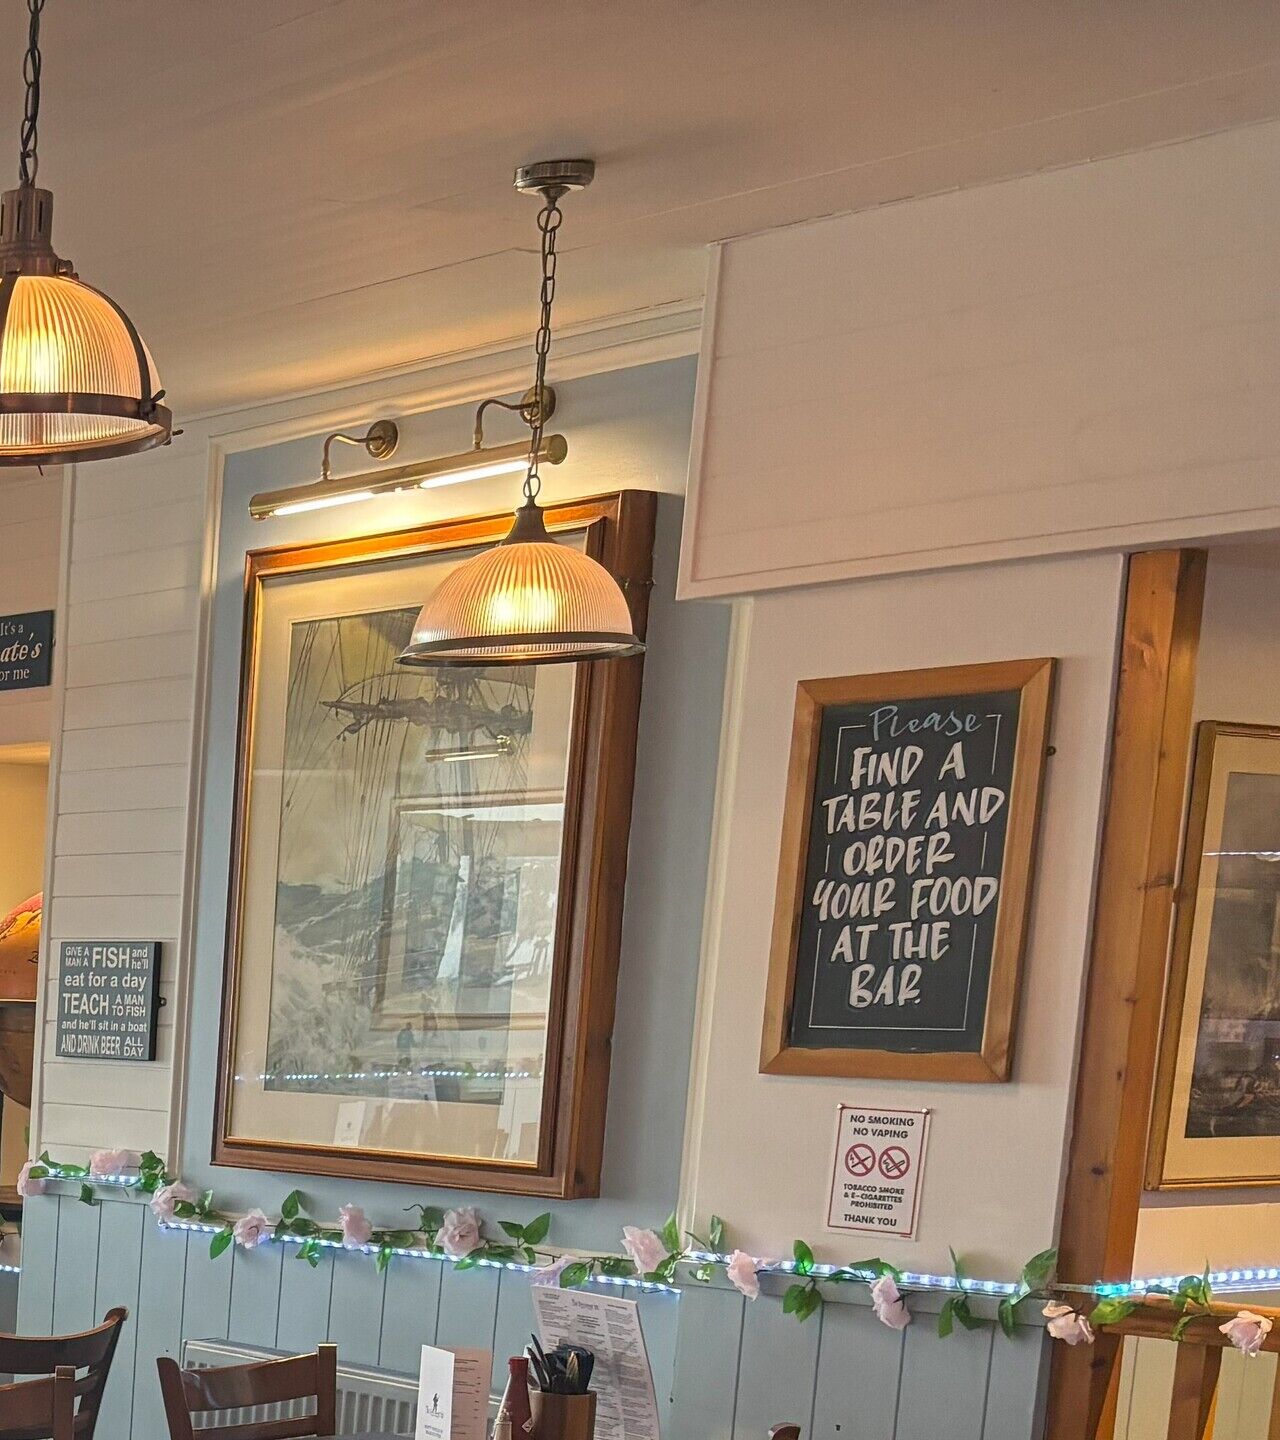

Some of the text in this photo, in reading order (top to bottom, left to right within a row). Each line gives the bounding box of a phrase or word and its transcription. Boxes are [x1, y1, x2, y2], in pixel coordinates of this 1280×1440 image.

[0, 622, 24, 636] It's a
[13, 668, 30, 680] me
[868, 705, 982, 742] Please
[850, 741, 966, 790] FIND A
[822, 786, 1005, 835] TABLE AND
[843, 831, 956, 876] ORDER
[812, 876, 998, 922] YOUR FOOD
[830, 921, 951, 963] AT THE
[65, 947, 90, 956] GIVE A
[92, 947, 130, 968] FISH
[132, 947, 148, 958] and
[65, 957, 89, 967] MAN A
[131, 959, 149, 970] he'll
[64, 971, 147, 992] eat for a day
[849, 963, 923, 1009] BAR.
[63, 993, 109, 1015] TEACH
[115, 994, 144, 1005] A MAN
[112, 1005, 146, 1017] TO FISH
[61, 1019, 147, 1032] and he'll sit in a boat
[61, 1034, 121, 1055] AND DRINK BEER
[124, 1036, 143, 1047] ALL
[123, 1046, 144, 1057] DAY
[850, 1114, 915, 1127] NO SMOKING
[853, 1127, 909, 1139] NO VAPING
[843, 1183, 905, 1195] TOBACCO SMOKE
[850, 1200, 893, 1210] PROHIBITED
[843, 1213, 897, 1226] THANK YOU
